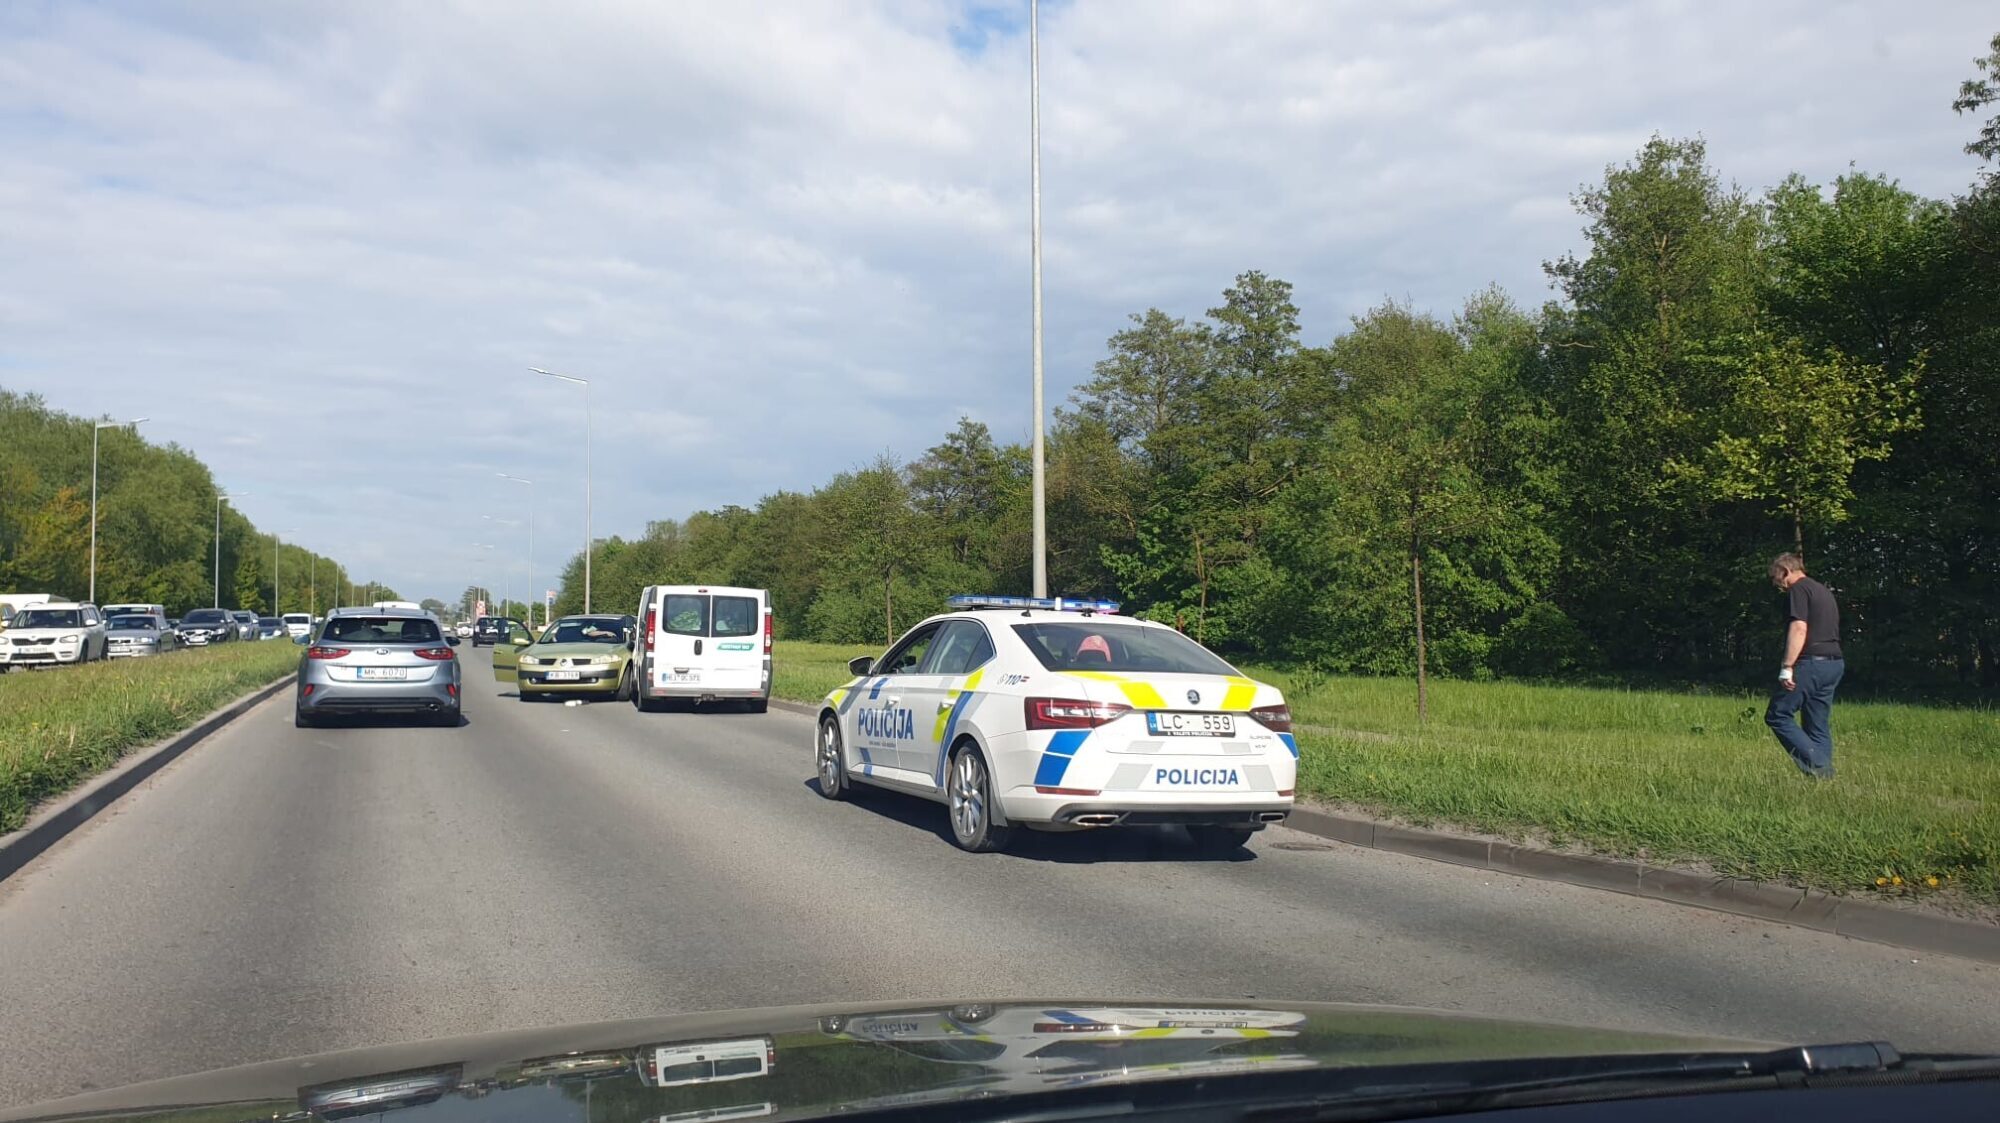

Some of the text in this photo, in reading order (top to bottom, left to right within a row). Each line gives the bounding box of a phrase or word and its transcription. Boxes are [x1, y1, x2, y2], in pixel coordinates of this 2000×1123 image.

[857, 708, 915, 740] POLICIJA
[1202, 715, 1231, 731] 559
[1156, 768, 1239, 785] POLICIJA
